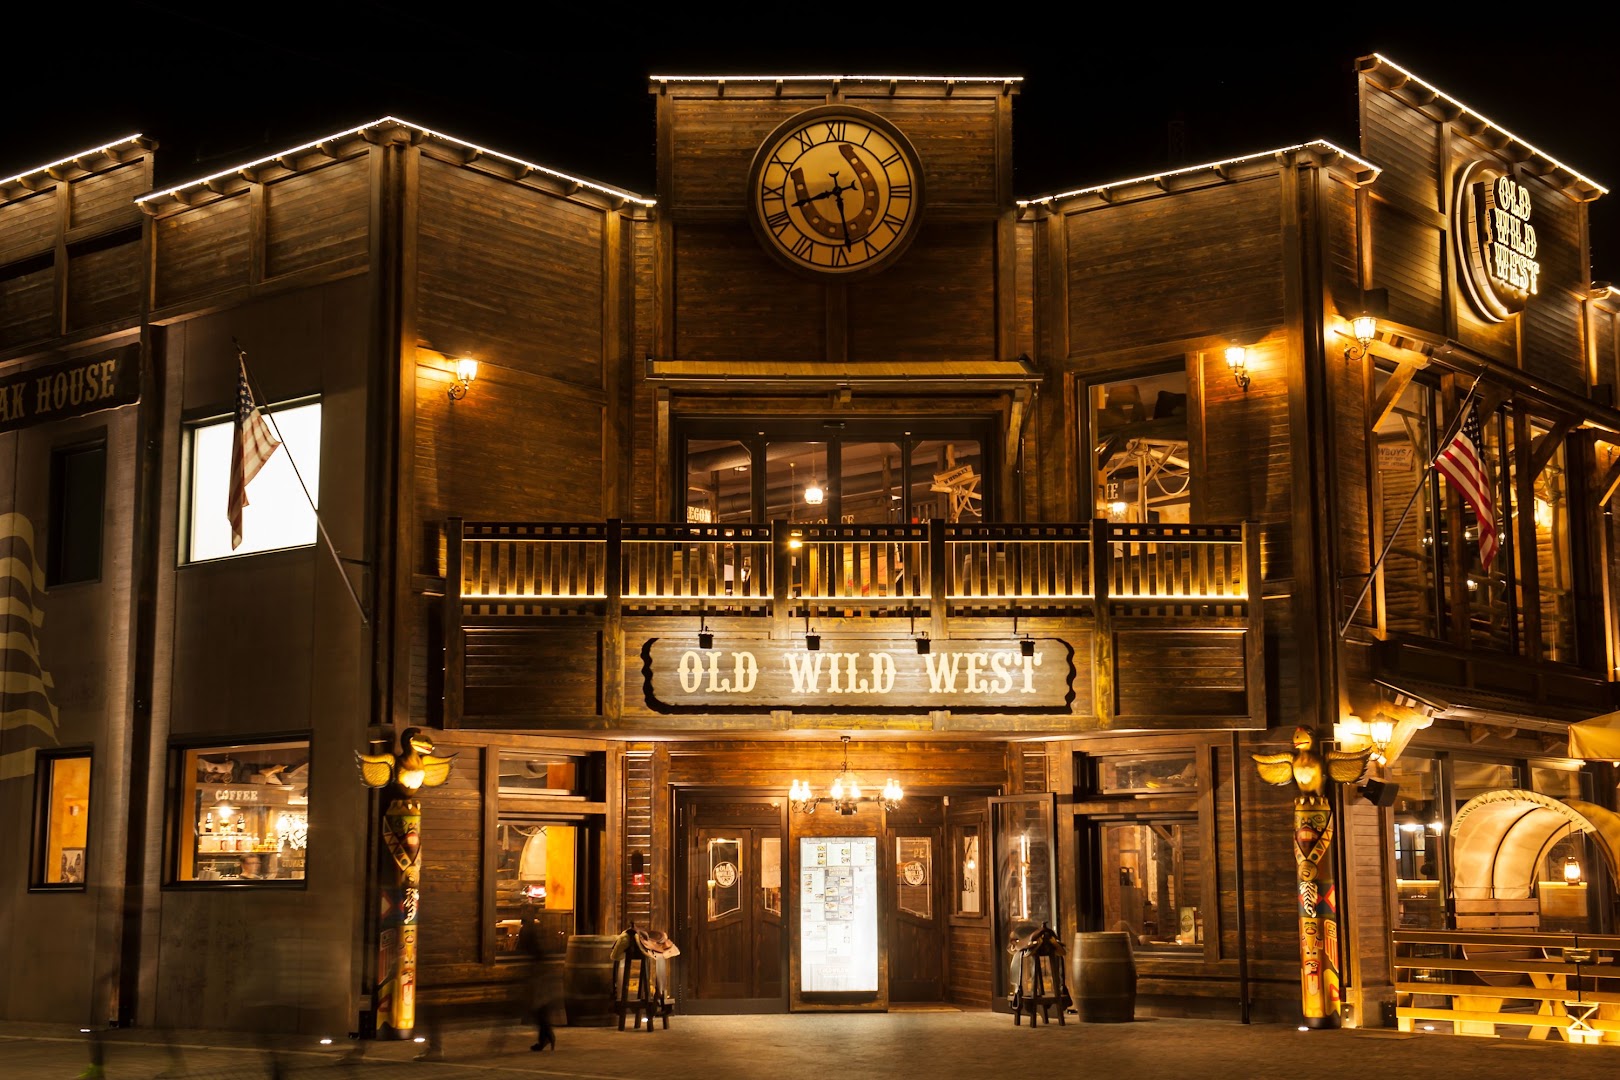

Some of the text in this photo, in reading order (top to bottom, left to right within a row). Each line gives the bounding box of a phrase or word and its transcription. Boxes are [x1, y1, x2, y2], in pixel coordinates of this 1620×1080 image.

[1498, 175, 1532, 222] OLD
[1494, 208, 1538, 259] WILD
[1494, 242, 1541, 295] WEST
[35, 359, 117, 414] HOUSE
[943, 467, 969, 485] WHISKEY
[687, 505, 712, 524] EGON
[676, 650, 1043, 694] OLD WILD WEST
[215, 789, 258, 801] COFFEE
